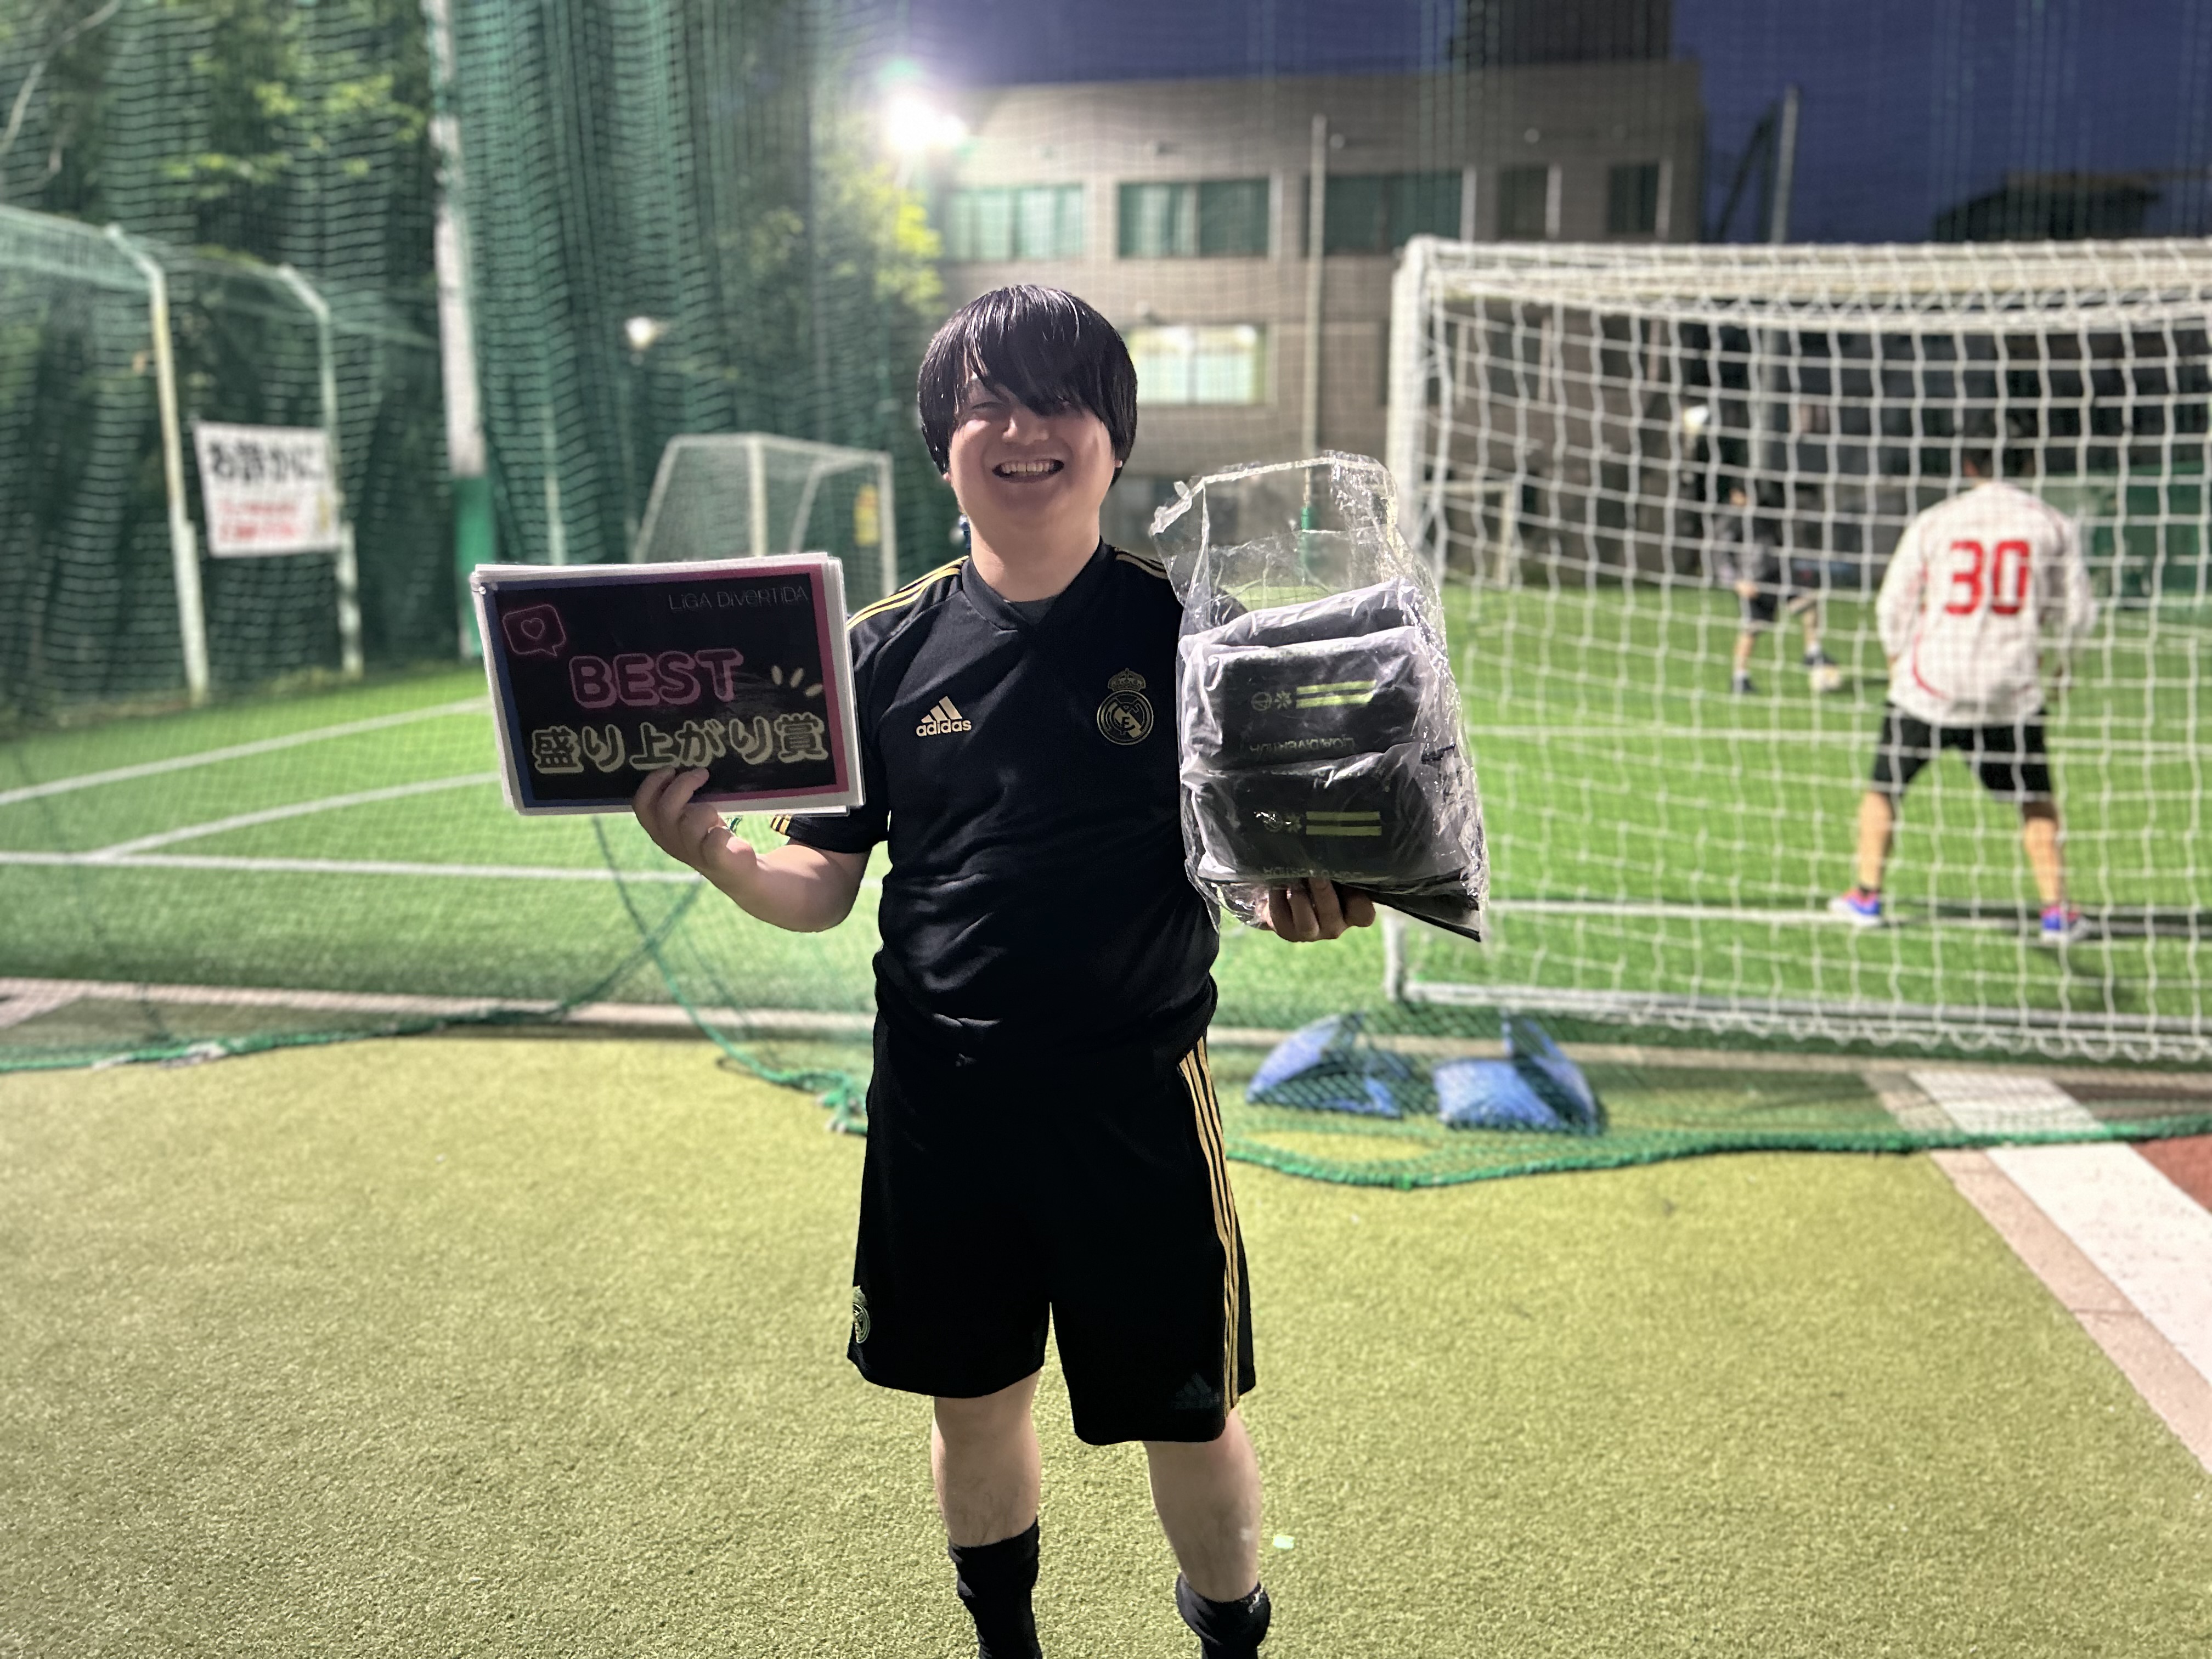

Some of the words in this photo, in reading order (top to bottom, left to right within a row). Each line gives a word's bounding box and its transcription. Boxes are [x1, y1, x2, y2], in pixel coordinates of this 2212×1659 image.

[1945, 540, 2030, 616] 30
[568, 648, 744, 708] BEST
[531, 712, 828, 774] 盛り上がり賞
[916, 719, 972, 737] adidas
